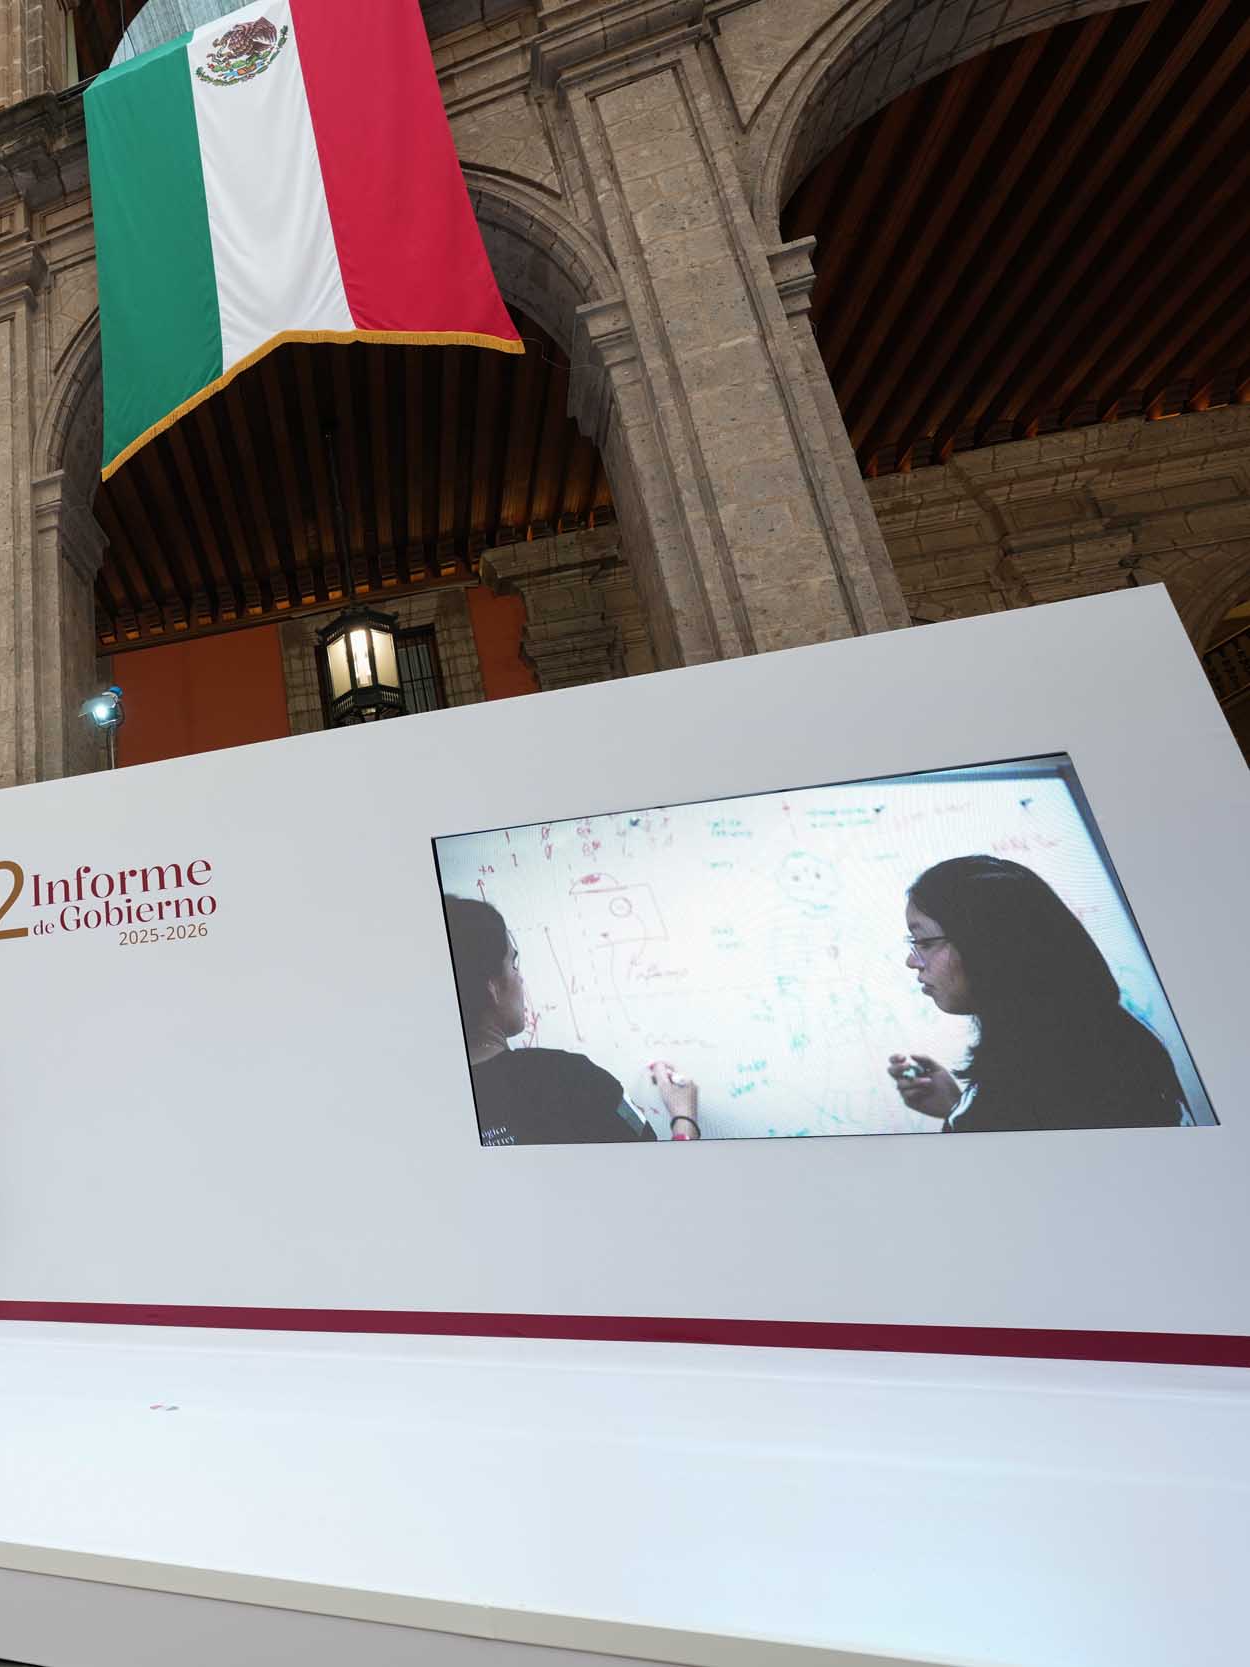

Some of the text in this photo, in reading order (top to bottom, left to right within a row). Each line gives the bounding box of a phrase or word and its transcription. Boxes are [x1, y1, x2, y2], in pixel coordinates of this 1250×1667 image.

[30, 858, 212, 907] Informe
[33, 894, 218, 936] de Gobierno
[118, 922, 208, 946] 2025-2026
